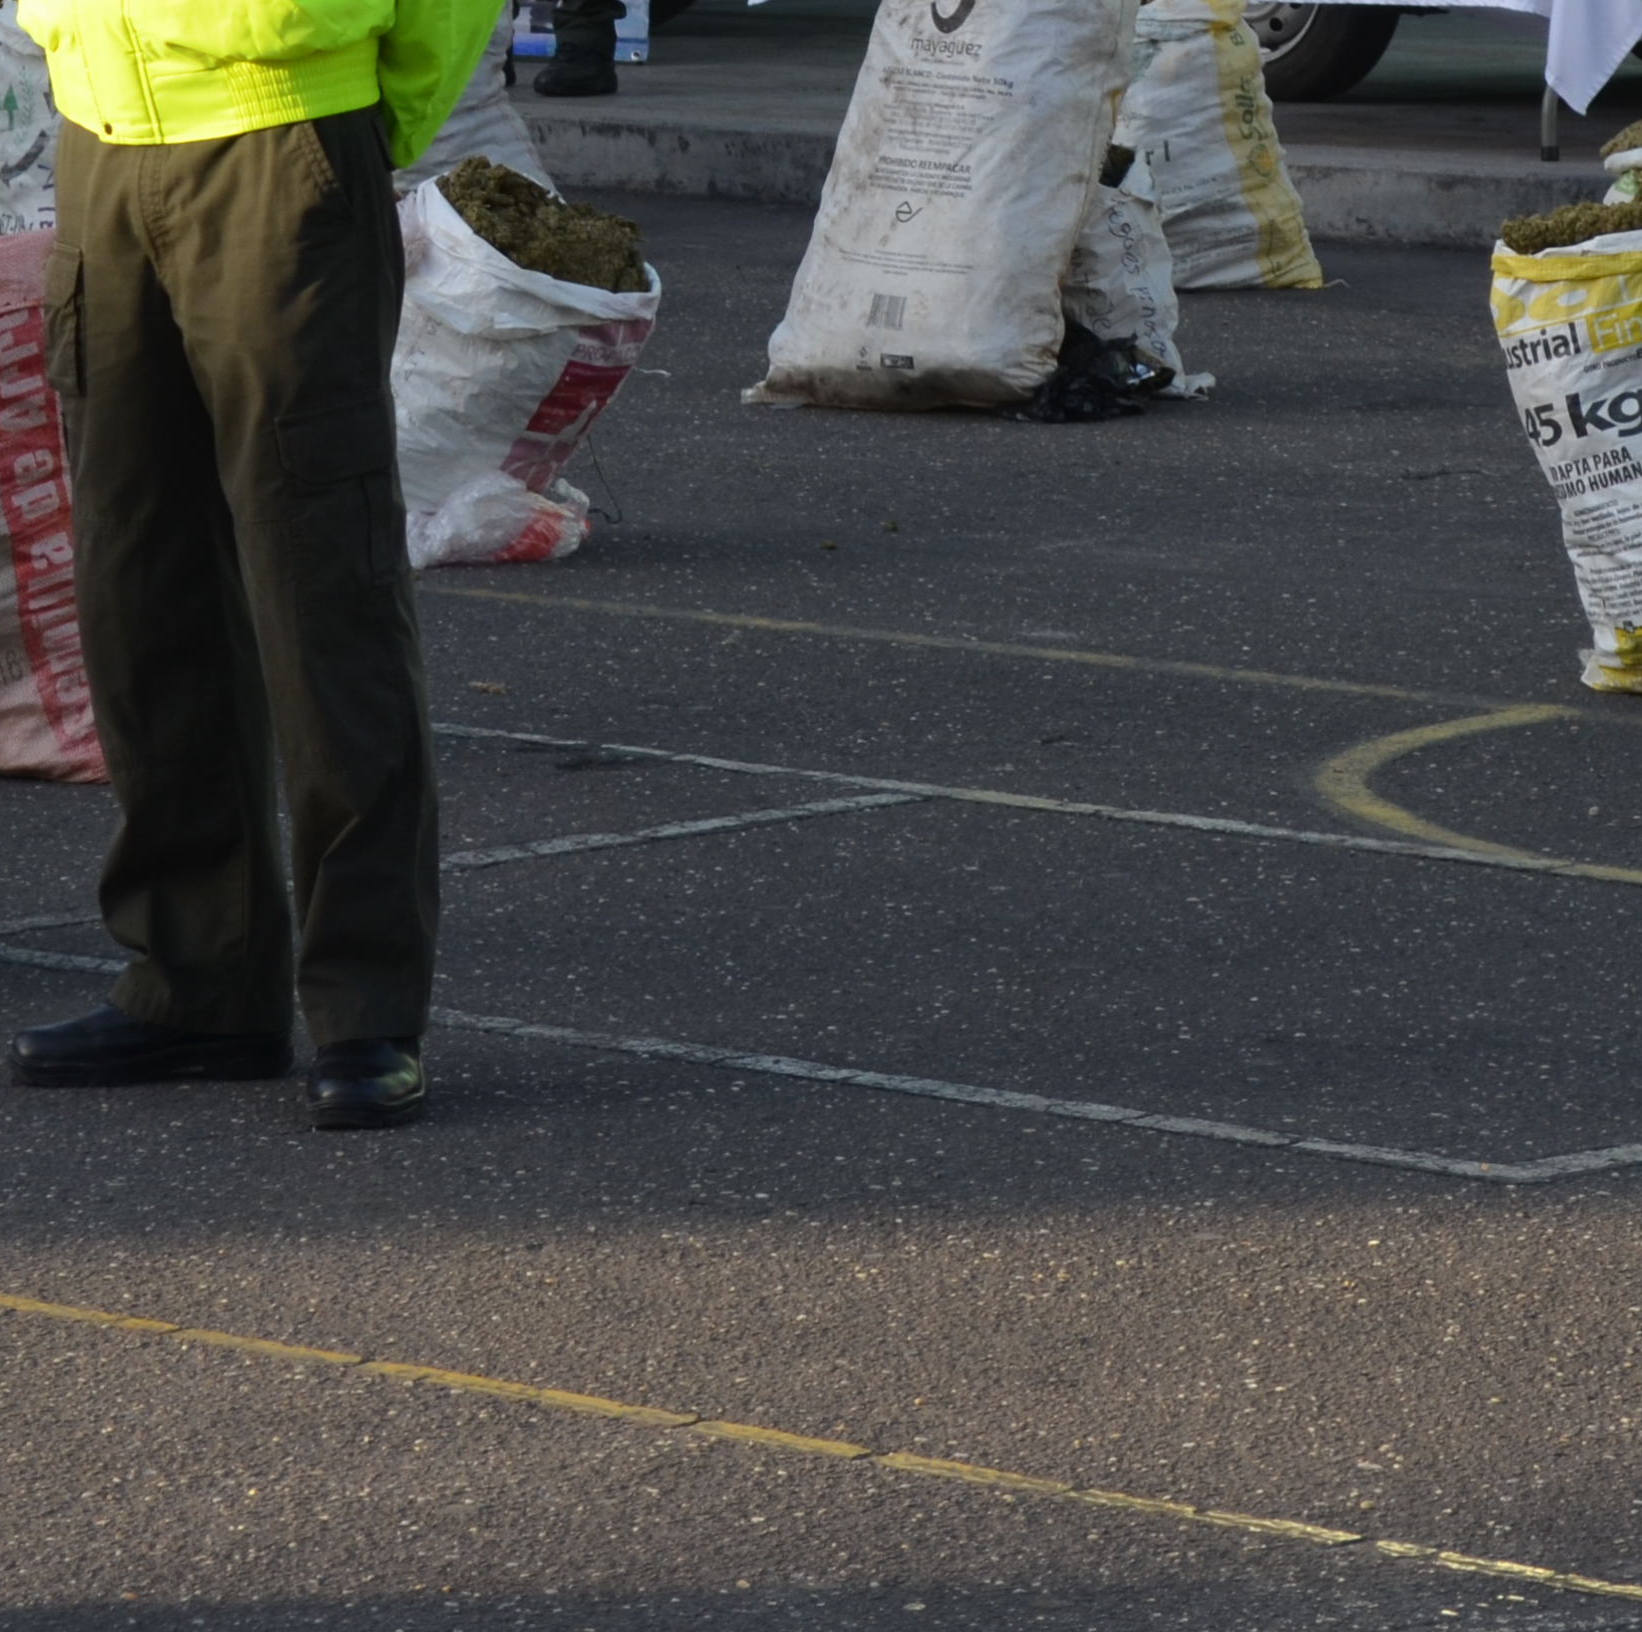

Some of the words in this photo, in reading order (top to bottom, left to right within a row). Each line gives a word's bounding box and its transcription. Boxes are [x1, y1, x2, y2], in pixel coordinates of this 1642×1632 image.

[1524, 403, 1563, 447] 45
[1593, 446, 1633, 469] PARA
[11, 449, 61, 520] de
